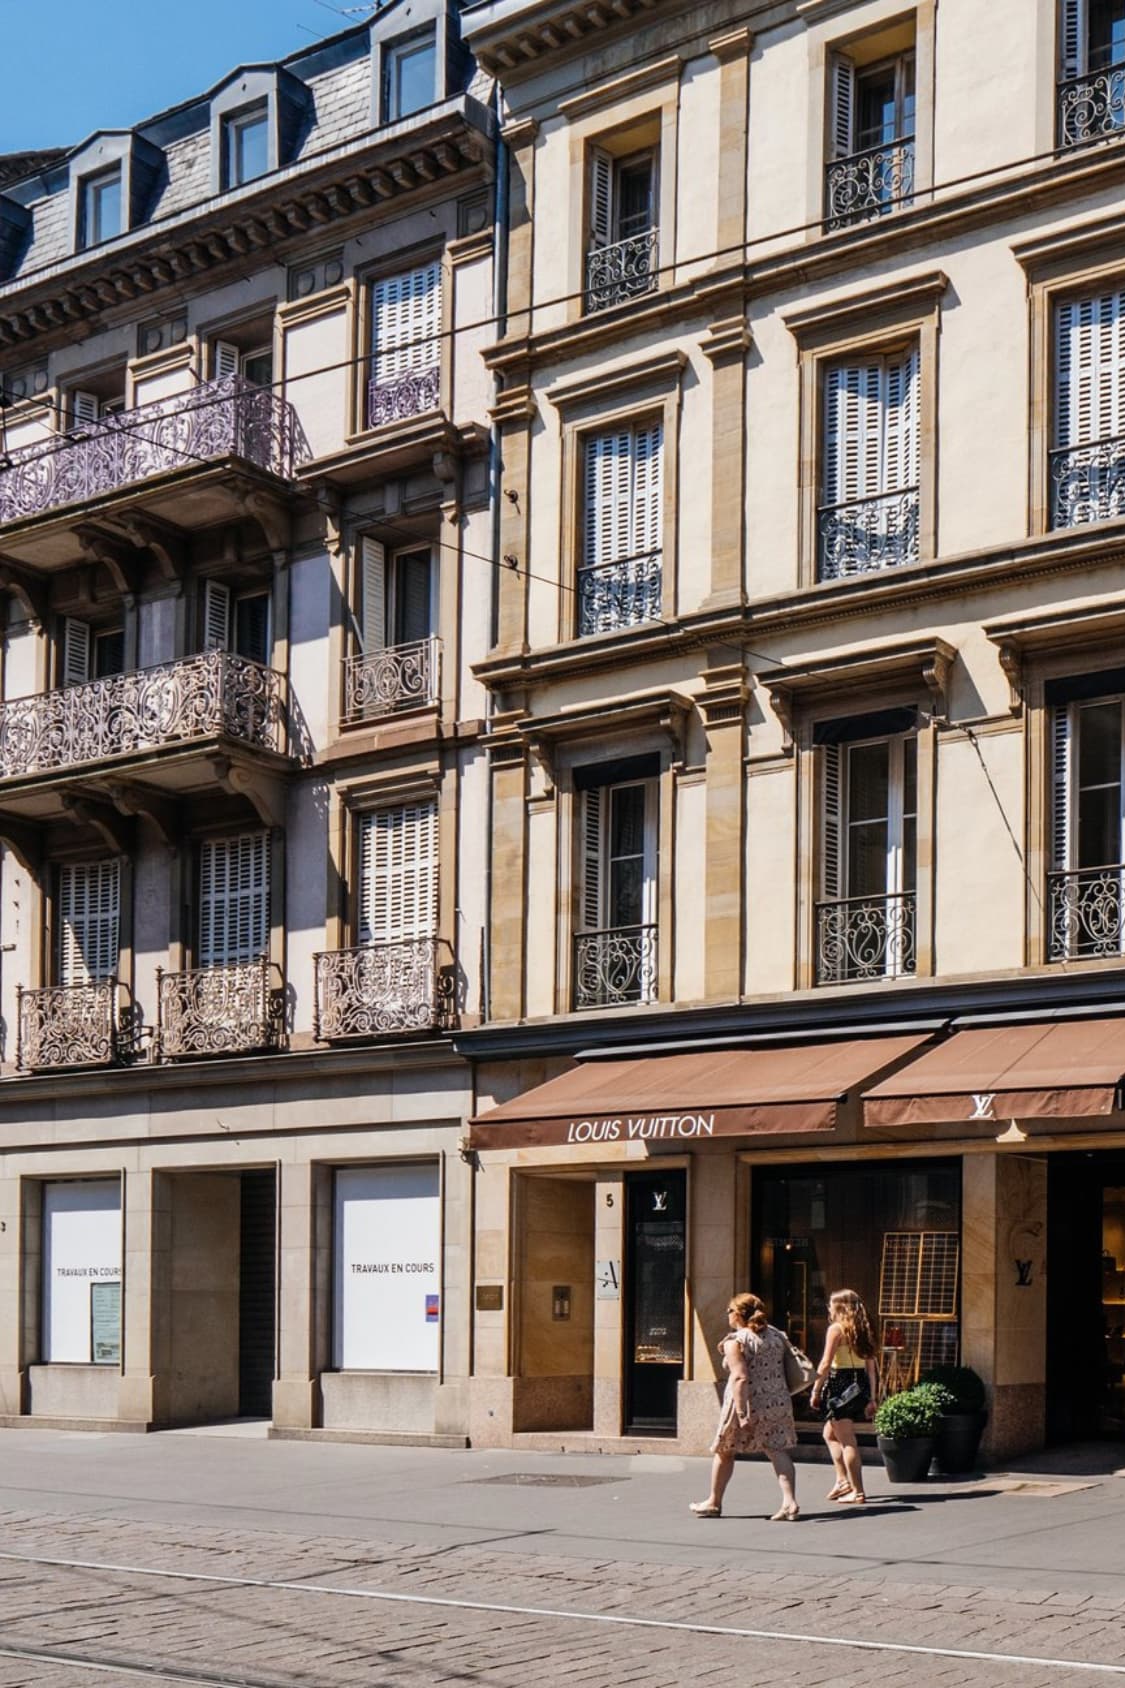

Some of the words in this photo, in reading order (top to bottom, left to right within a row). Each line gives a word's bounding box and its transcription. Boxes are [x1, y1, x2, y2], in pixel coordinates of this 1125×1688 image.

[567, 1119, 622, 1143] LOUIS
[628, 1114, 715, 1139] VUITTON
[606, 1193, 615, 1208] 5
[57, 1267, 88, 1277] TRAVAUX
[89, 1267, 99, 1277] EN
[351, 1263, 390, 1274] TRAVAUX
[391, 1263, 404, 1274] EN
[405, 1262, 434, 1273] COURS
